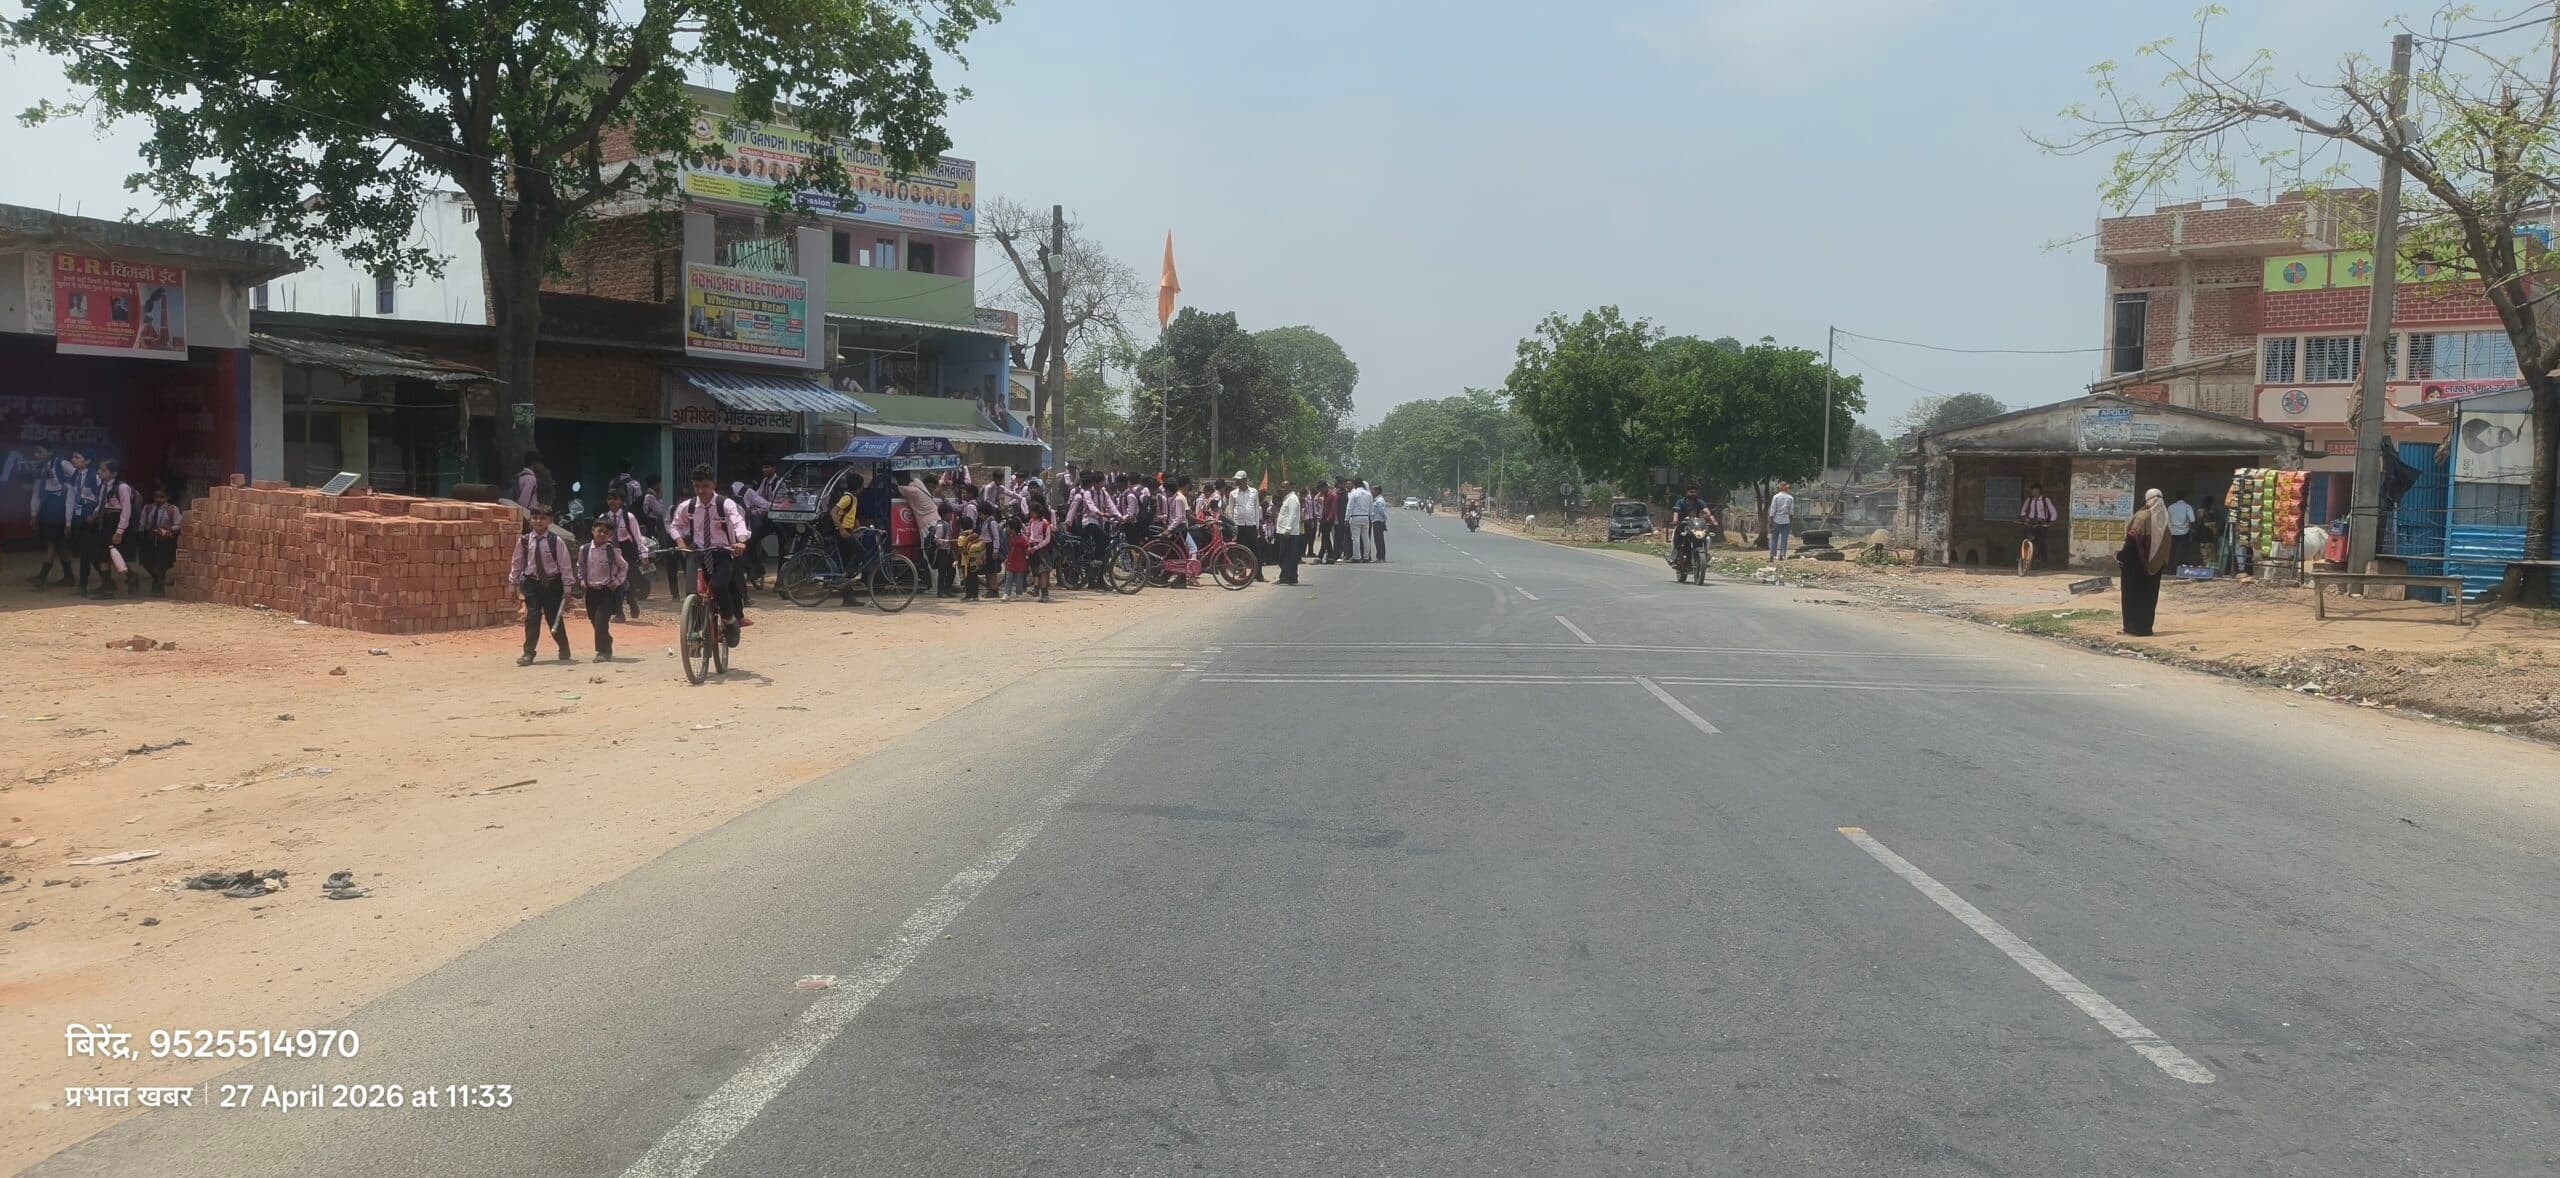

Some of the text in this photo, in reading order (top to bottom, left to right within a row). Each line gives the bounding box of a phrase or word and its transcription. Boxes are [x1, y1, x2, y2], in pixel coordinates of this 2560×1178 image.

[750, 130, 788, 151] GANDHI
[841, 147, 884, 167] CHILDREN
[690, 271, 741, 293] ABHISHEK
[744, 280, 805, 300] ELECTRONICS
[706, 294, 753, 309] Wholesale
[762, 302, 787, 314] Retail
[860, 440, 888, 451] Amul
[917, 437, 935, 447] Amul
